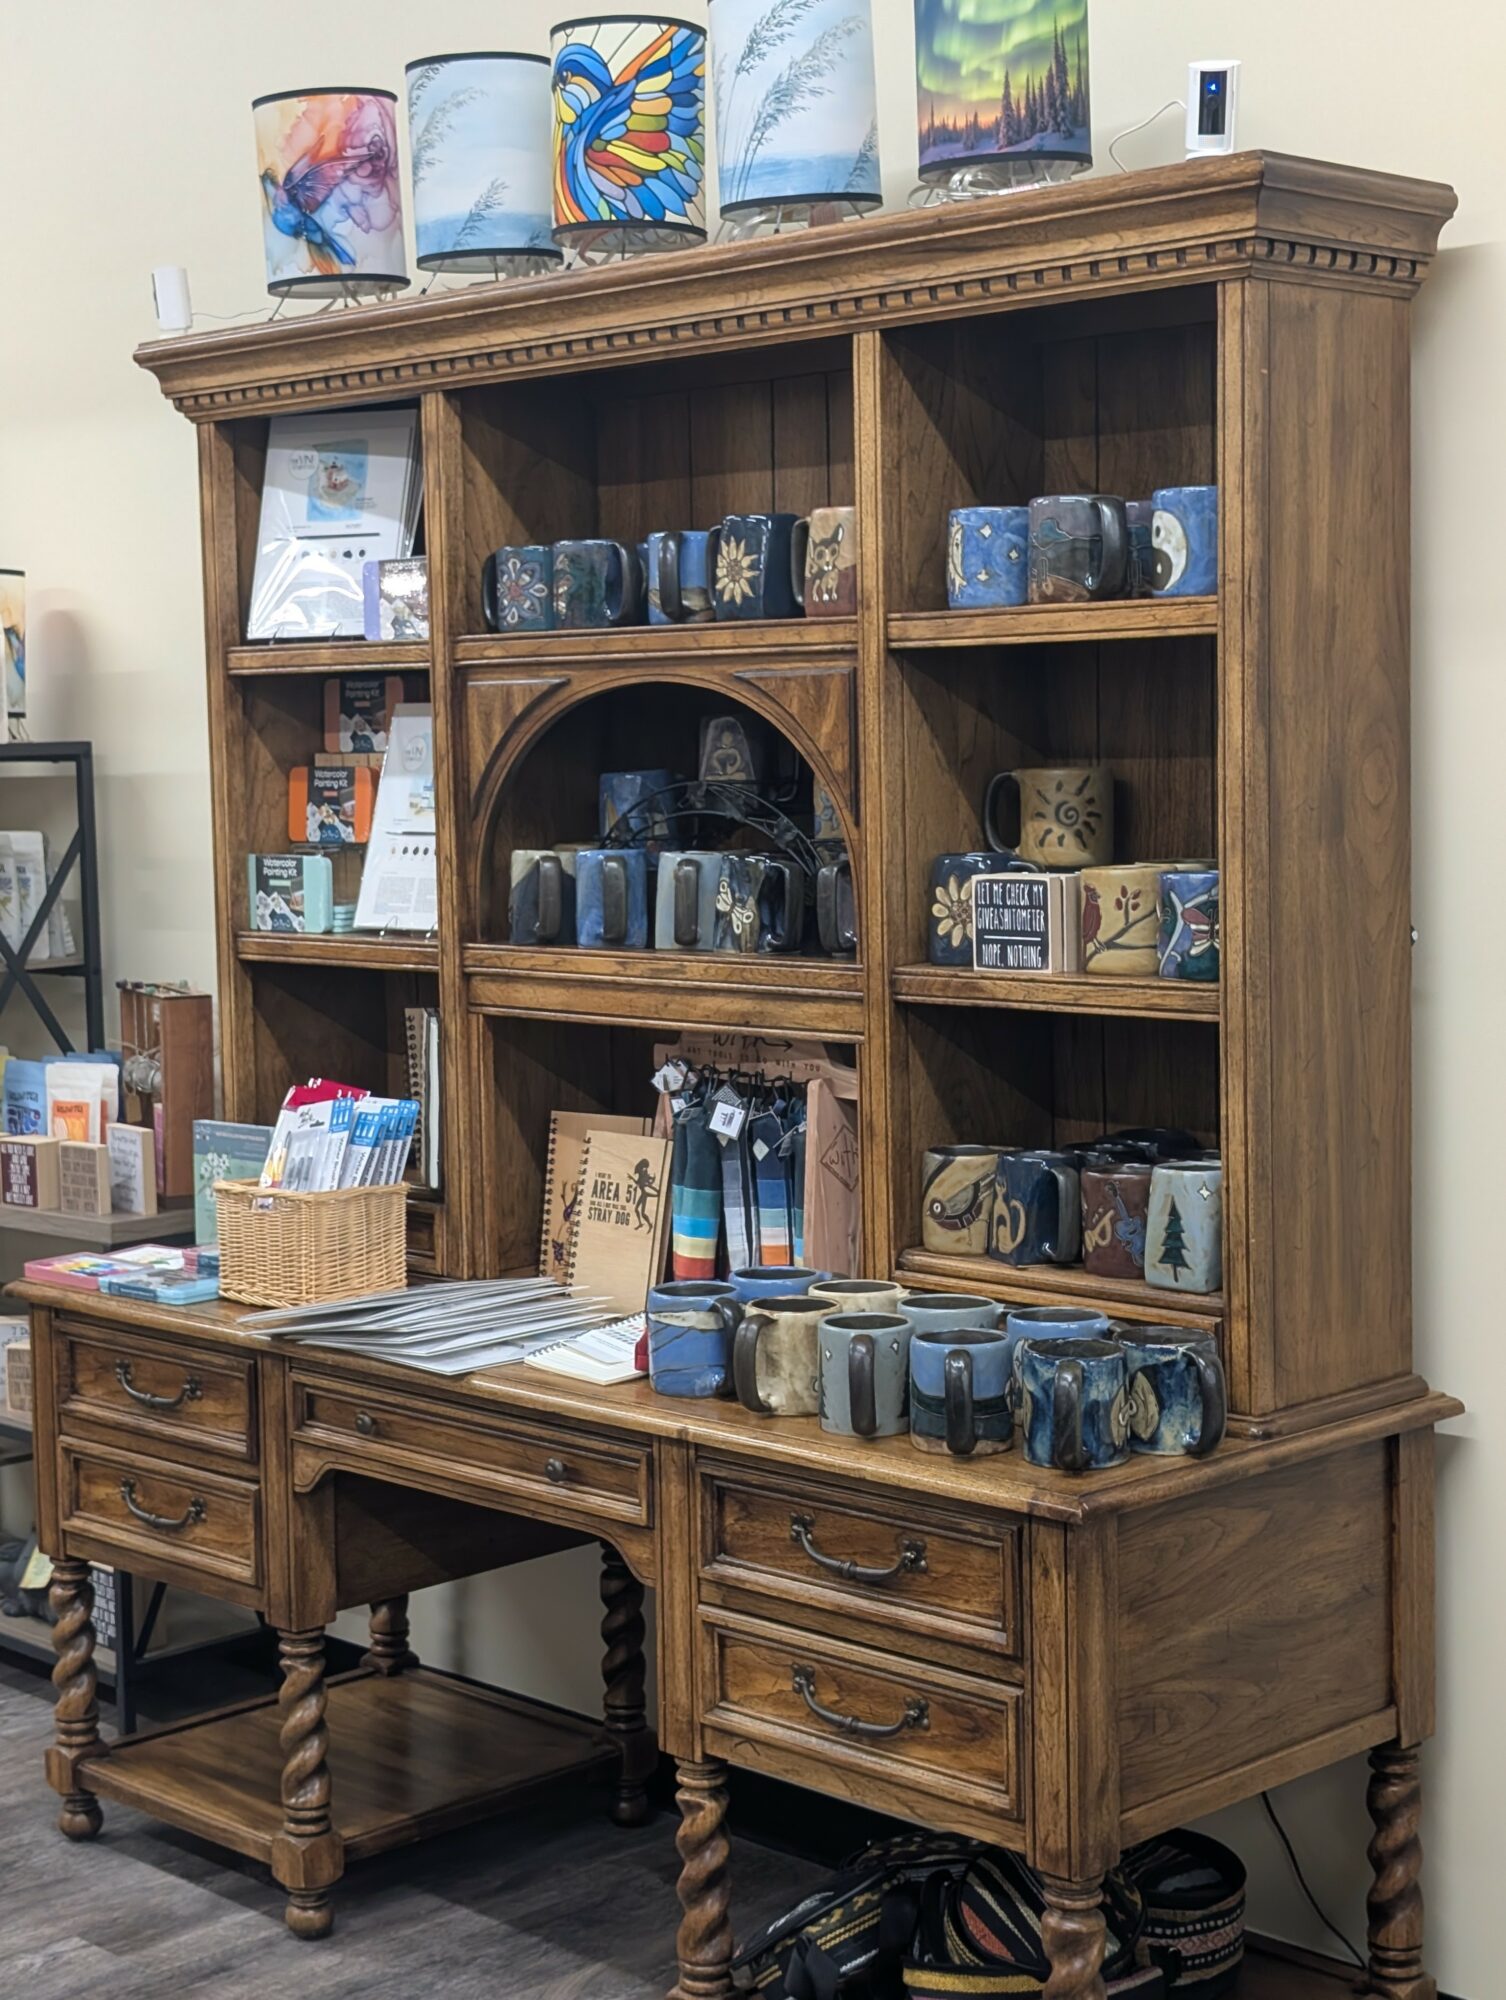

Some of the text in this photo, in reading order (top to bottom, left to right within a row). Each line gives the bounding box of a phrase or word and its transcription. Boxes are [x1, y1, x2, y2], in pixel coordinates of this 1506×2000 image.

[314, 770, 348, 778] Watercolor
[314, 779, 348, 789] Painting Kit
[263, 859, 297, 867] Watercolor
[263, 867, 297, 878] Painting Kit
[977, 882, 1044, 906] LET ME CHECK MY
[977, 907, 1046, 932] GIVEASHITOMETER
[1007, 945, 1042, 968] NOTHING
[591, 1179, 638, 1204] AREA 51
[587, 1206, 631, 1226] STRAY DOG
